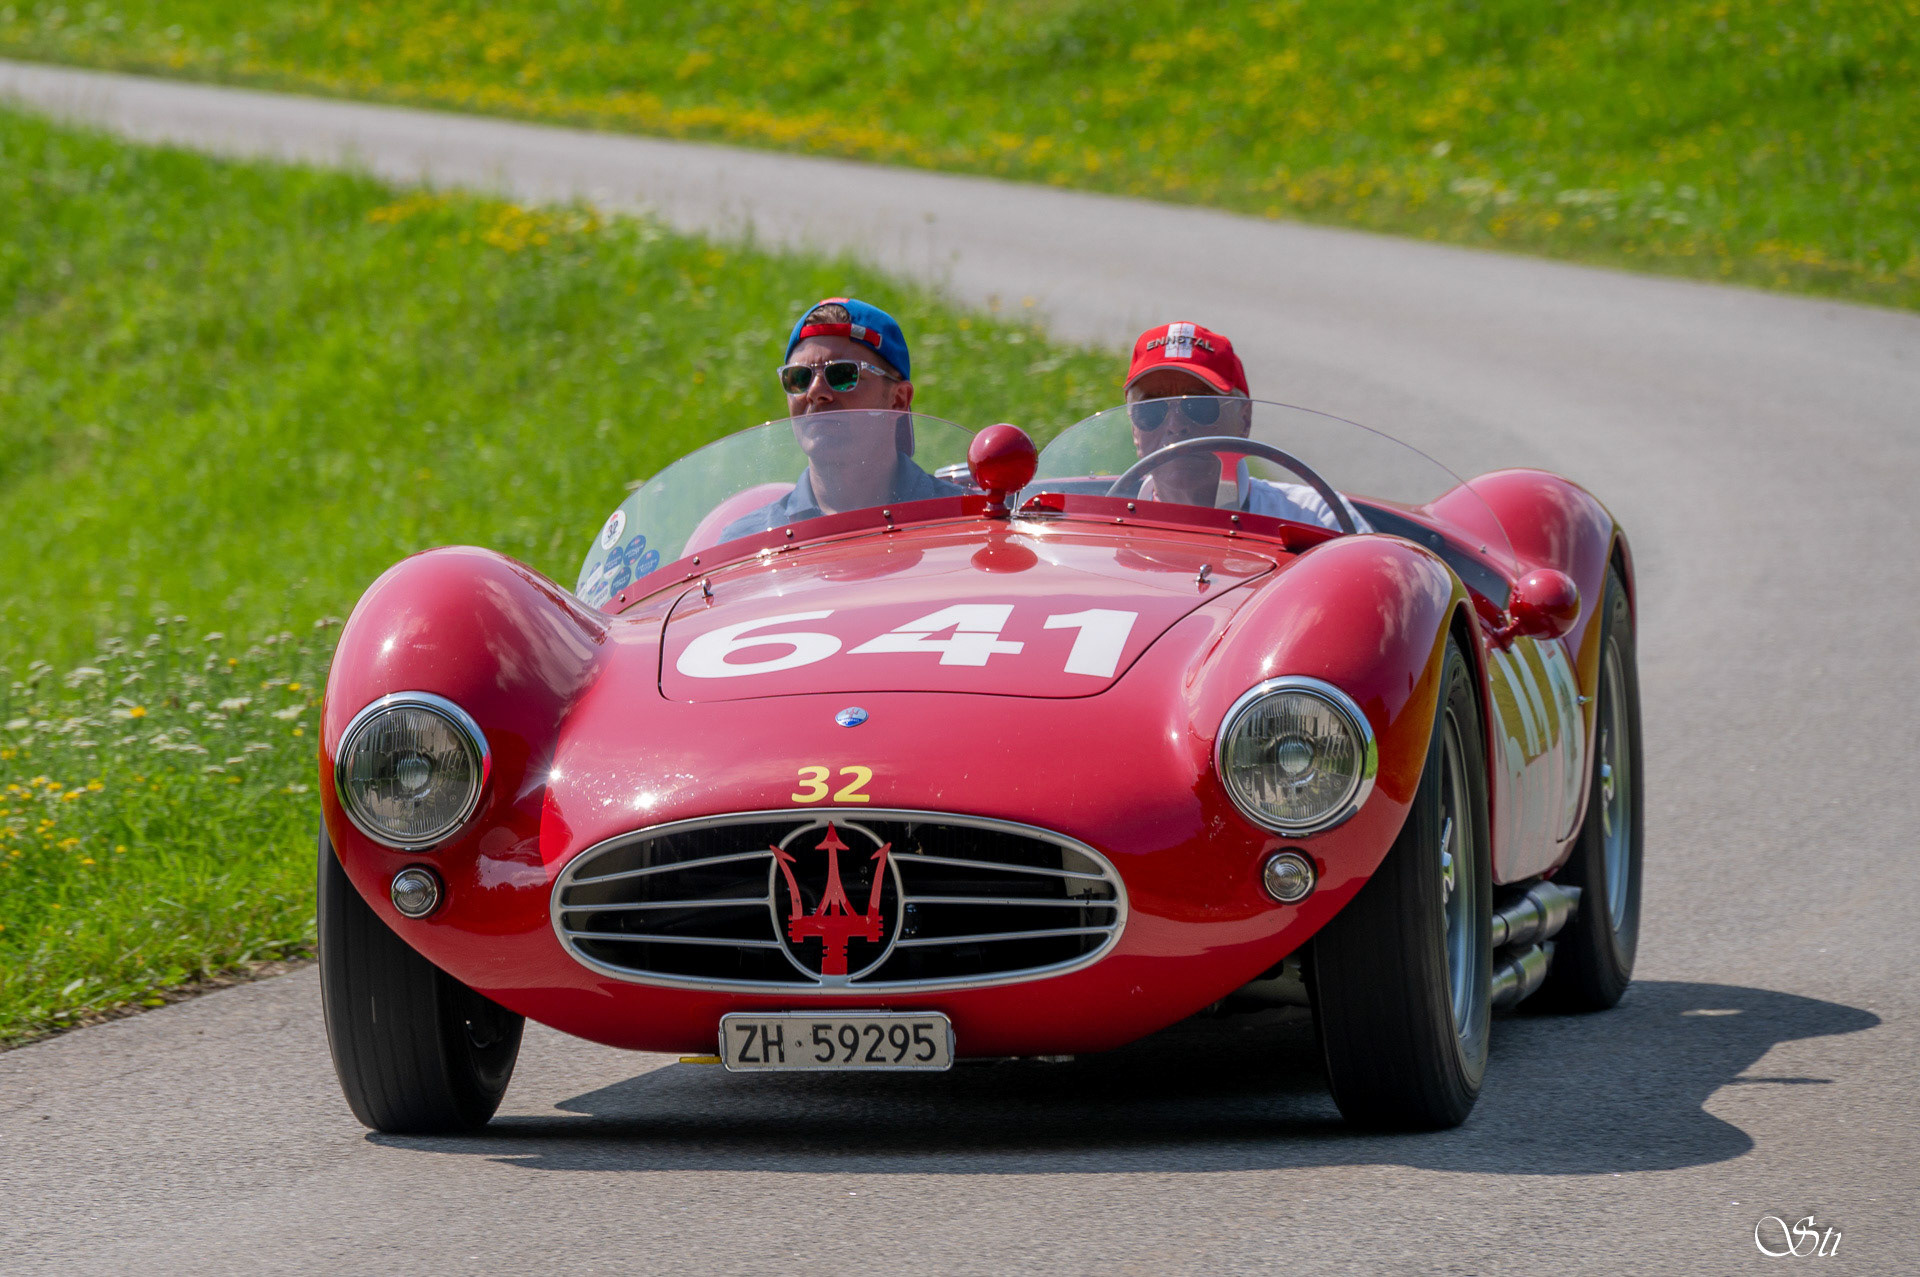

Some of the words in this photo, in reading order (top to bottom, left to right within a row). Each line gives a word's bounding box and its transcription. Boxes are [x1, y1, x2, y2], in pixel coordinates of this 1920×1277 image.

[1146, 336, 1215, 352] ENNSTAL
[676, 604, 1138, 678] 641
[791, 765, 873, 803] 32
[735, 1023, 785, 1063] ZH
[811, 1023, 936, 1063] 59295
